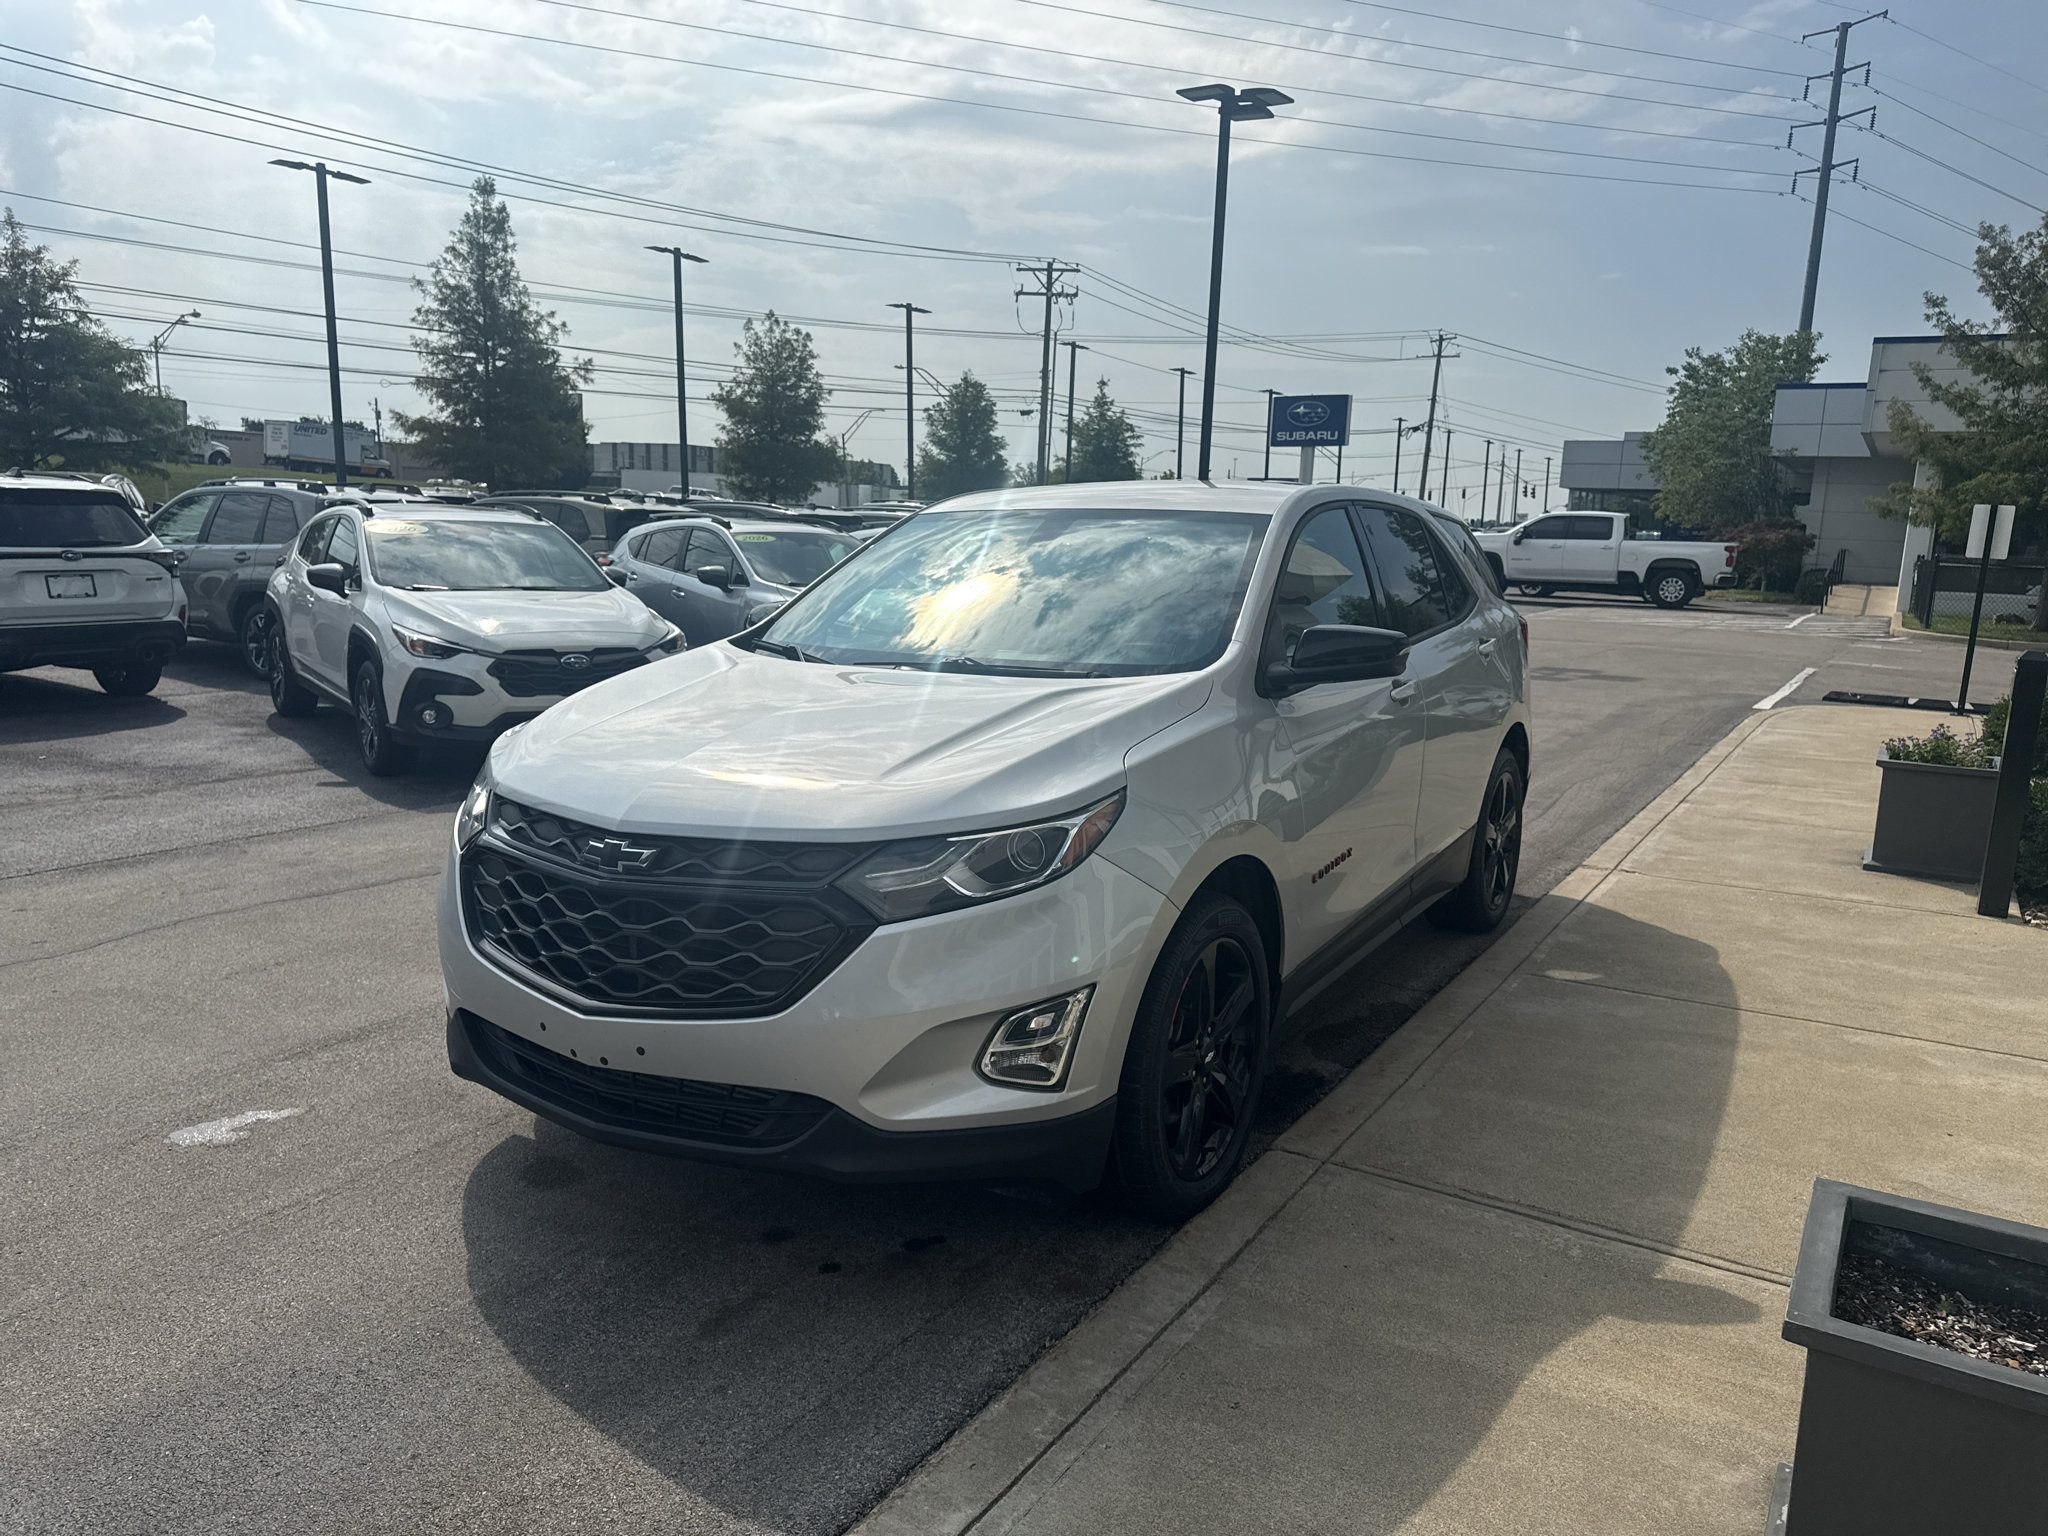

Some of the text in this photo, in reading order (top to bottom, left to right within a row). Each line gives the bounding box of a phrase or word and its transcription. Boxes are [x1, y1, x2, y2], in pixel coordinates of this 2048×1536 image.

[294, 424, 328, 436] UNITED
[1276, 431, 1338, 441] SUBARU
[1311, 847, 1353, 884] EQUINOX
